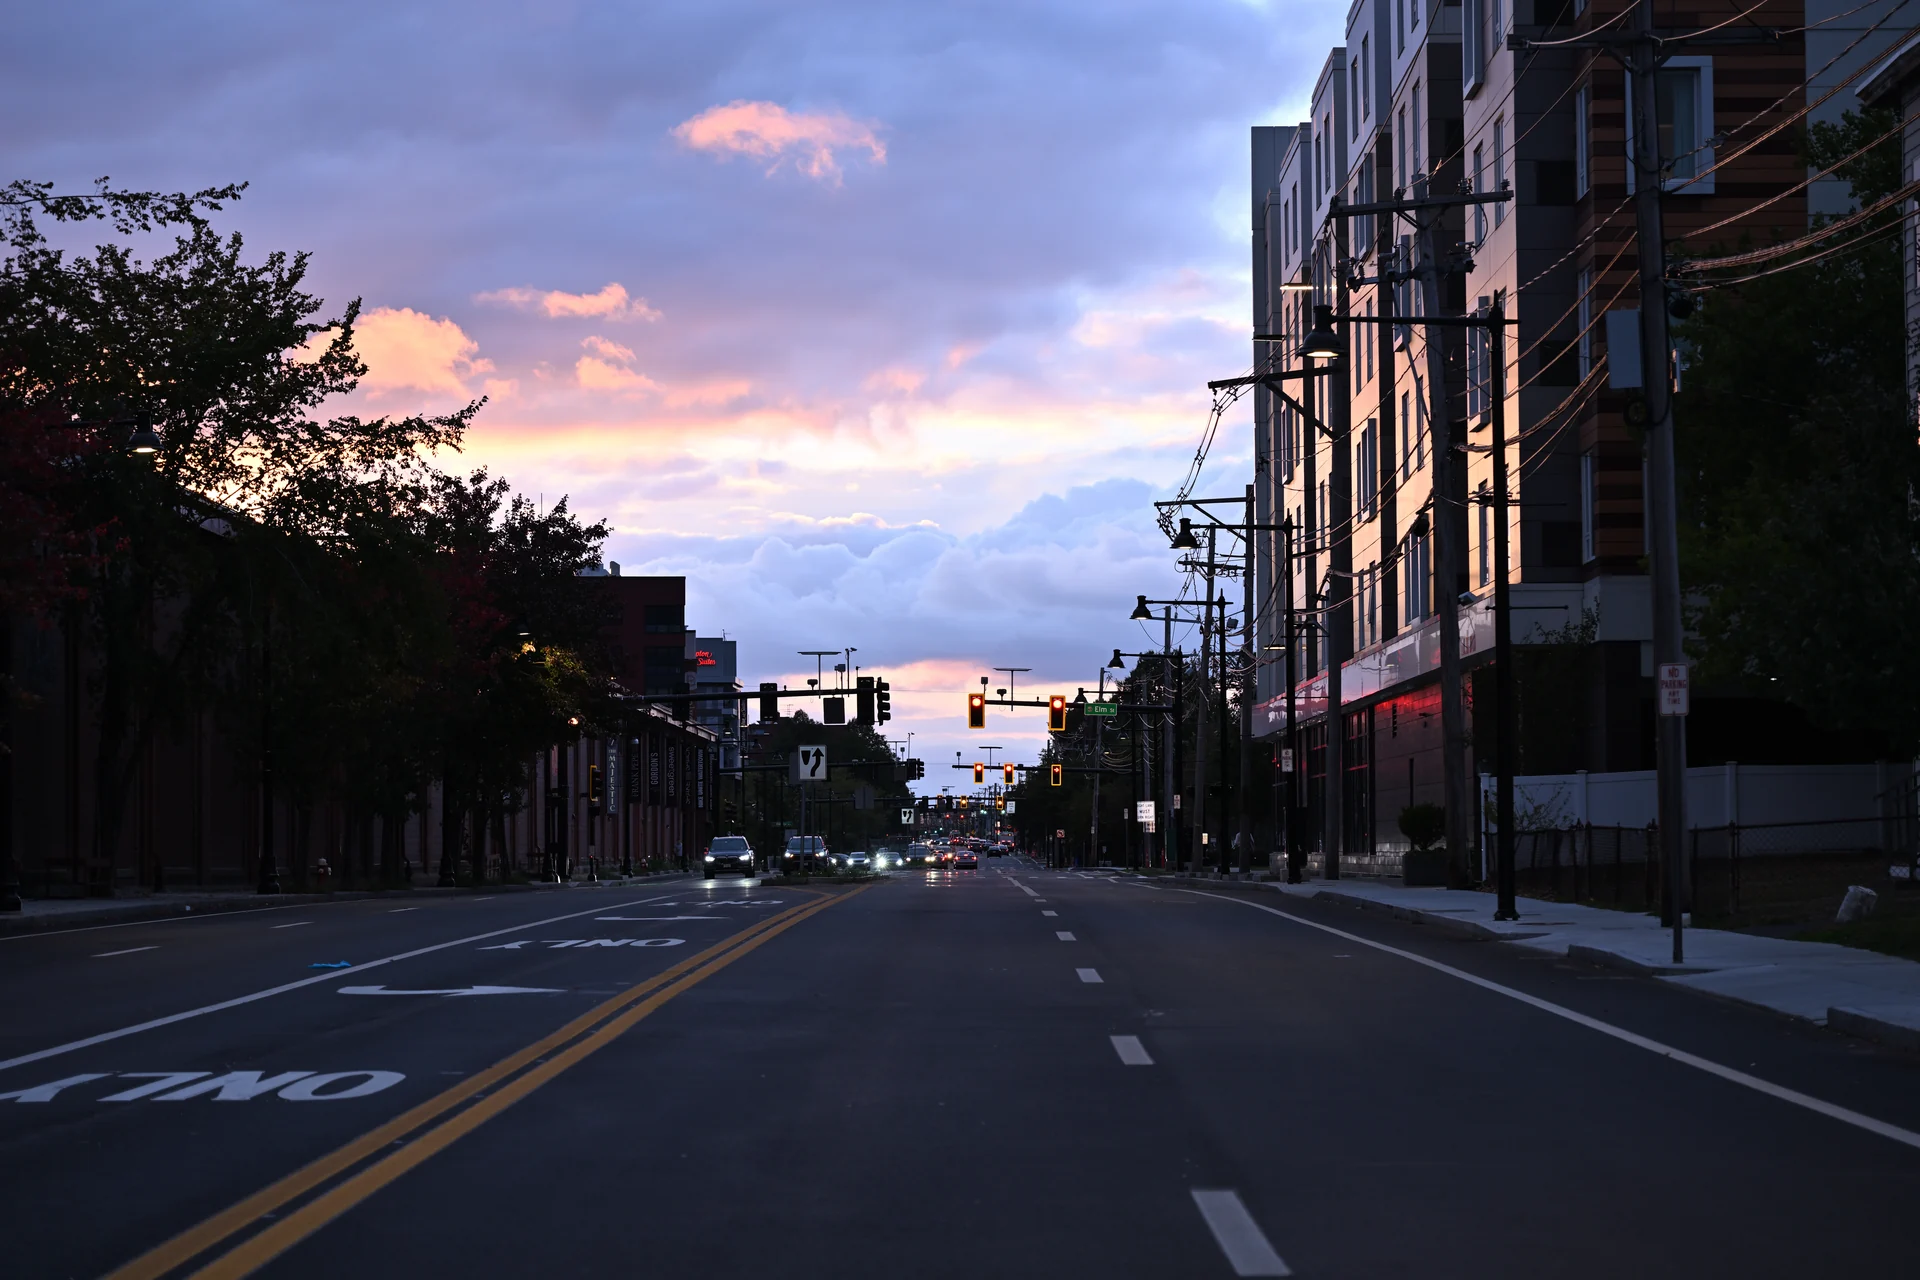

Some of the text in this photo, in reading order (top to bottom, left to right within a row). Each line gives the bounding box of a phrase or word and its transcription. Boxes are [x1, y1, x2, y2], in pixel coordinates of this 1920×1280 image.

[697, 657, 717, 667] Suites
[1668, 668, 1679, 678] NO
[1661, 680, 1687, 689] PARKING
[1094, 705, 1108, 713] Elm
[650, 752, 659, 785] GORDON'S
[667, 746, 675, 797] sweetgreen
[608, 755, 616, 812] MAJESTIC
[631, 771, 639, 797] FRANK
[476, 938, 687, 950] ONLY
[0, 1070, 407, 1103] ONLY
